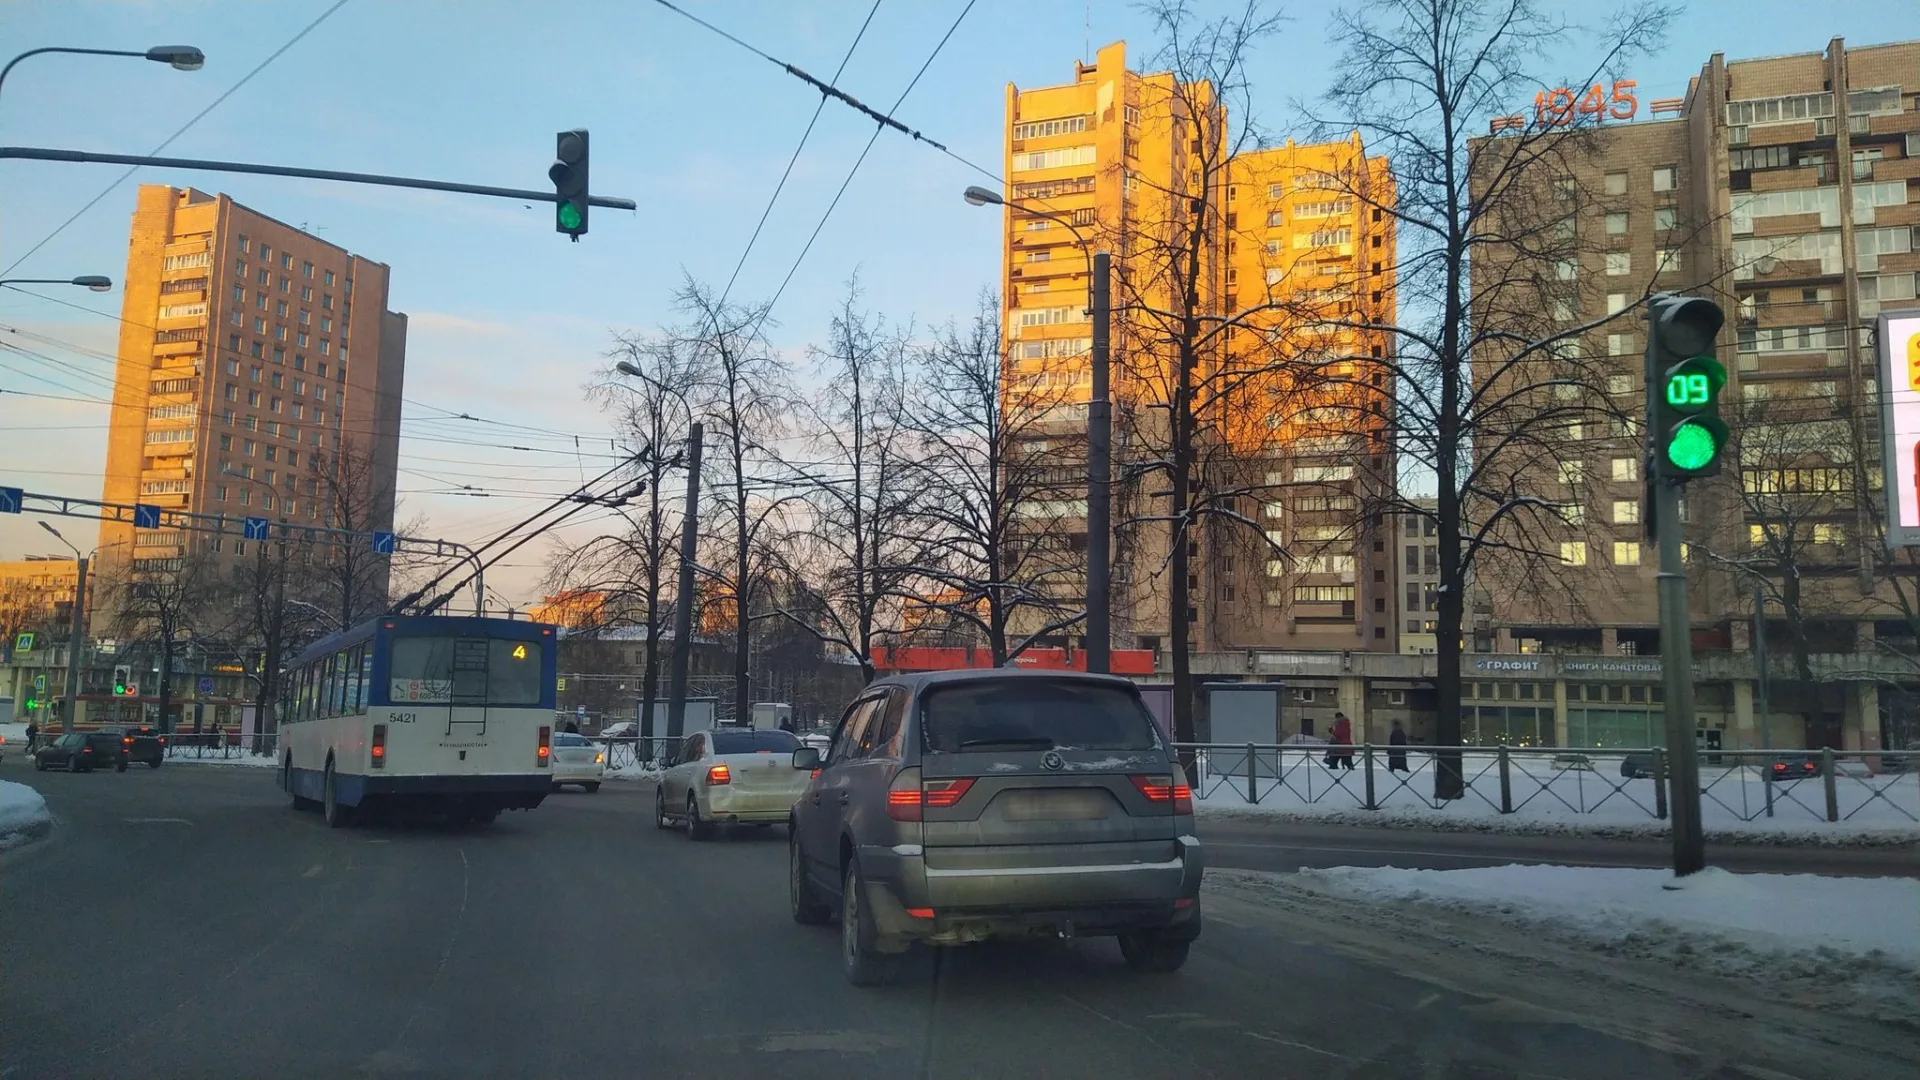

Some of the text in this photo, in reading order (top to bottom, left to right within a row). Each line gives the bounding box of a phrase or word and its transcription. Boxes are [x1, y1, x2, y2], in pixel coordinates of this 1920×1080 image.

[1534, 79, 1639, 128] 1945
[1666, 374, 1710, 405] 09
[512, 645, 526, 659] 4
[1486, 661, 1539, 671] ГРАФИТ
[1565, 663, 1663, 672] КНИГИ КАНЦТОВАР
[389, 712, 417, 724] 5421
